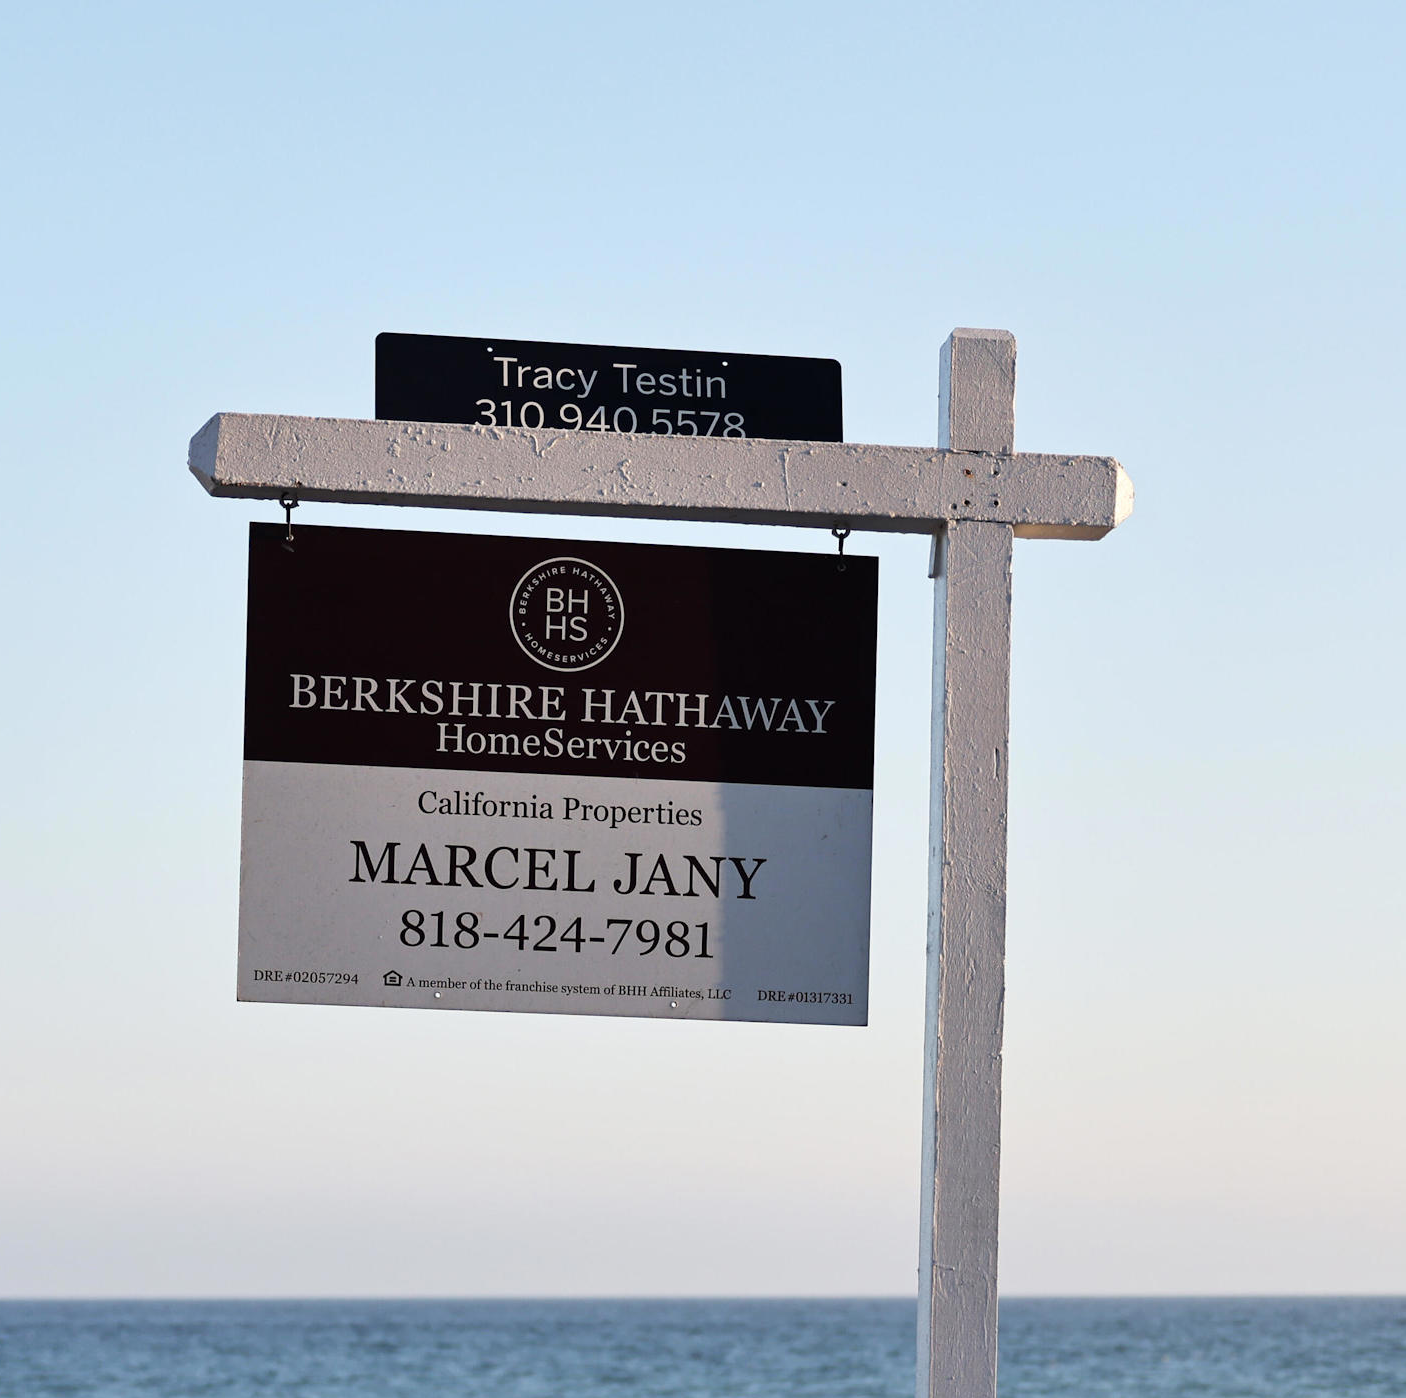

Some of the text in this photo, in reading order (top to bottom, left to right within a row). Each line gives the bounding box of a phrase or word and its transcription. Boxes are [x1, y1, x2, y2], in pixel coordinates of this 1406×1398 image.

[493, 356, 726, 399] Tracy Testin
[518, 566, 616, 620] BERKSHIRE HATHAWAY
[546, 587, 589, 614] BH
[524, 632, 608, 663] HOMESERVICES
[545, 614, 588, 642] HS
[289, 673, 836, 734] BERKSHIRE HATHAWAY
[436, 722, 687, 764] HomeServices
[418, 790, 703, 829] California Properties
[348, 840, 768, 900] MARCEL JANY
[399, 909, 714, 959] 818-424-7981
[253, 969, 283, 982] DRE
[406, 977, 732, 1000] A member of the franchise system of BHH Affiliates, LLC
[758, 990, 786, 1002] DRE
